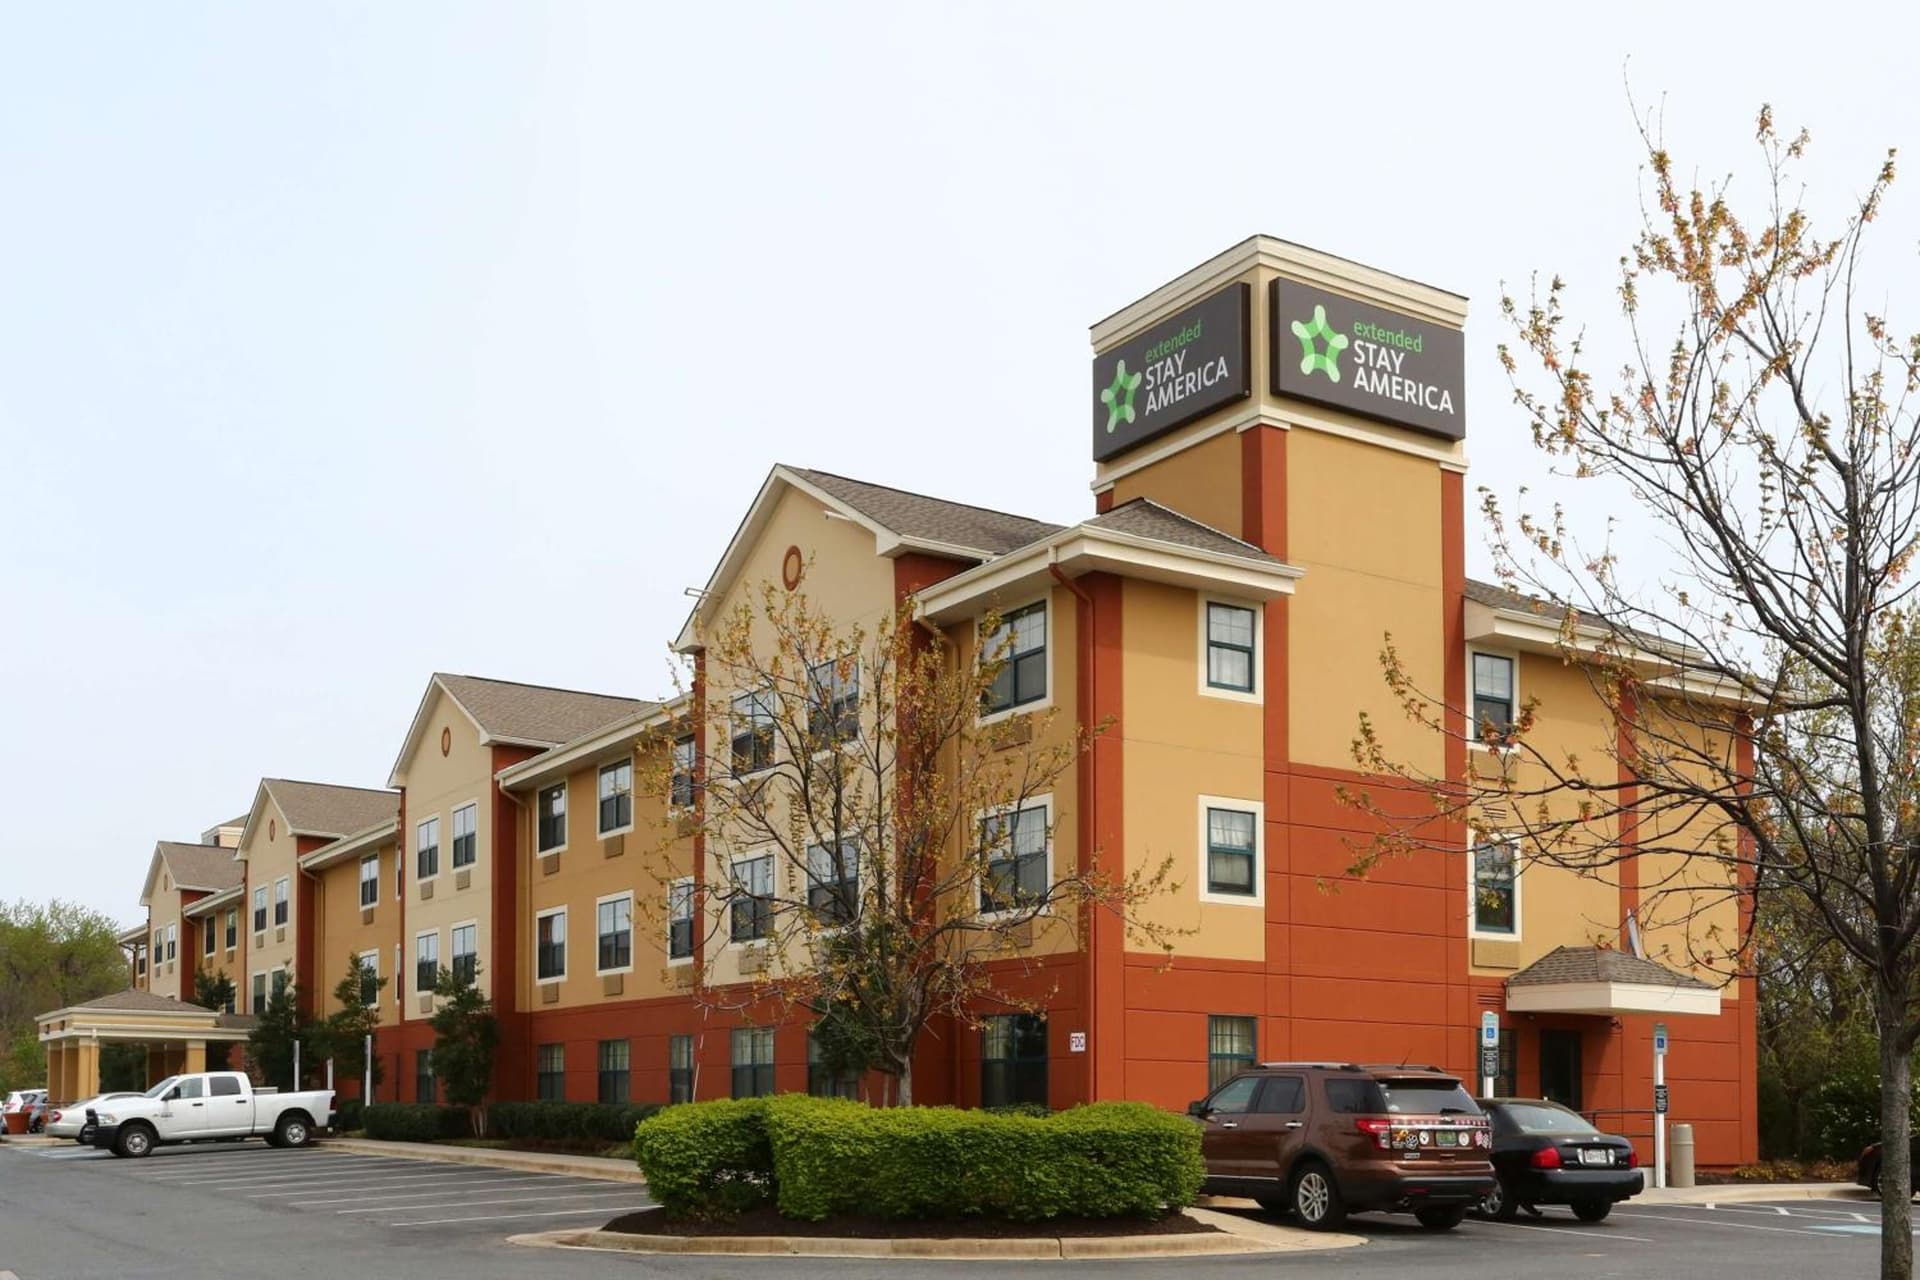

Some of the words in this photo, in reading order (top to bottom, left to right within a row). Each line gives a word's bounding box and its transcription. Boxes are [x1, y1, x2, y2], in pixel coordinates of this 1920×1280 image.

[1145, 318, 1202, 363] extended
[1353, 321, 1422, 353] extended
[1353, 339, 1405, 374] STAY
[1145, 349, 1186, 390] STAY
[1145, 356, 1229, 416] AMERICA
[1353, 366, 1454, 415] AMERICA
